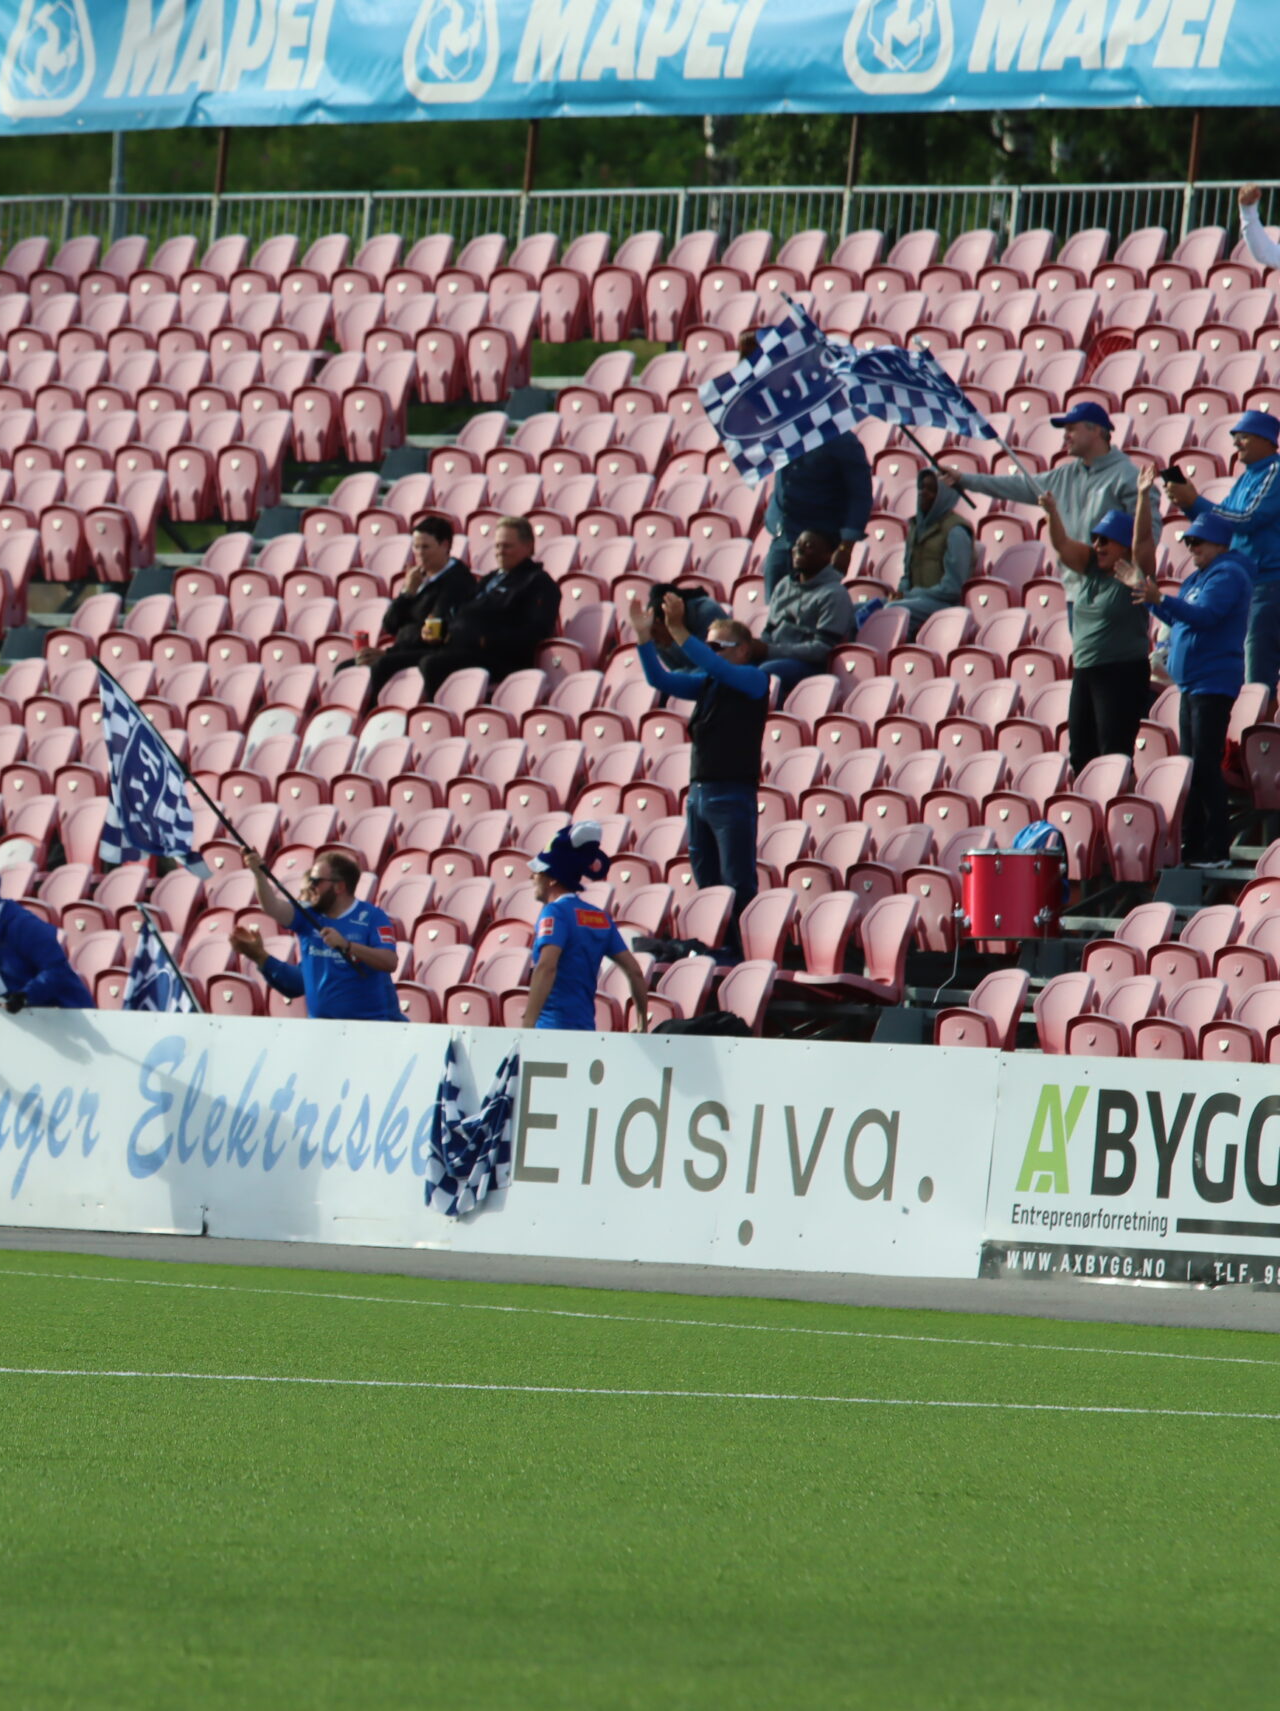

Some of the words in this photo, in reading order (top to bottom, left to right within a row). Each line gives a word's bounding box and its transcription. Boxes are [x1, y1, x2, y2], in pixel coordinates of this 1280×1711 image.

[104, 0, 333, 98] MAPEI
[513, 0, 762, 83] MAPEI
[967, 0, 1234, 73] MAPEI
[1011, 1203, 1169, 1238] Entreprenørforretning
[1006, 1250, 1166, 1278] WWW.AXBYGG.NO
